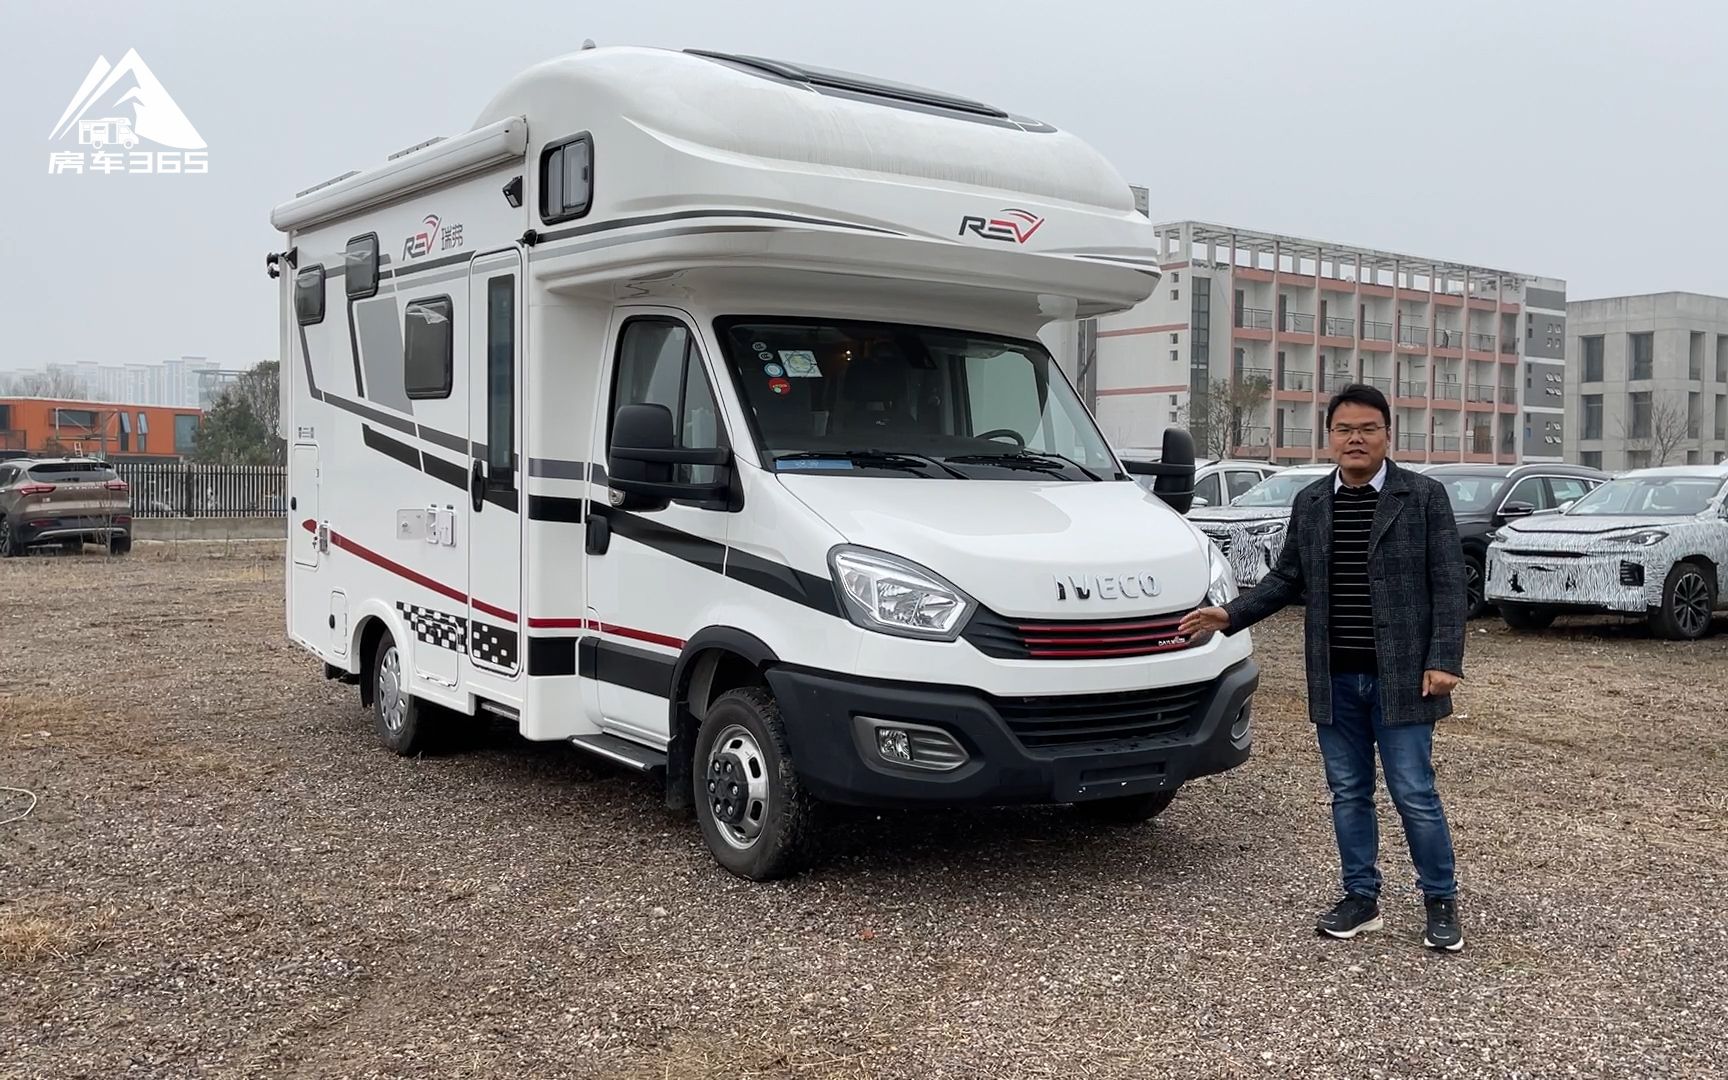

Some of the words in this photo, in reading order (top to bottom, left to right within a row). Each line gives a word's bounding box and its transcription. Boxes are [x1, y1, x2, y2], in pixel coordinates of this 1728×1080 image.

[402, 214, 442, 261] REV
[959, 210, 1045, 243] REV
[1053, 573, 1161, 600] IVECO
